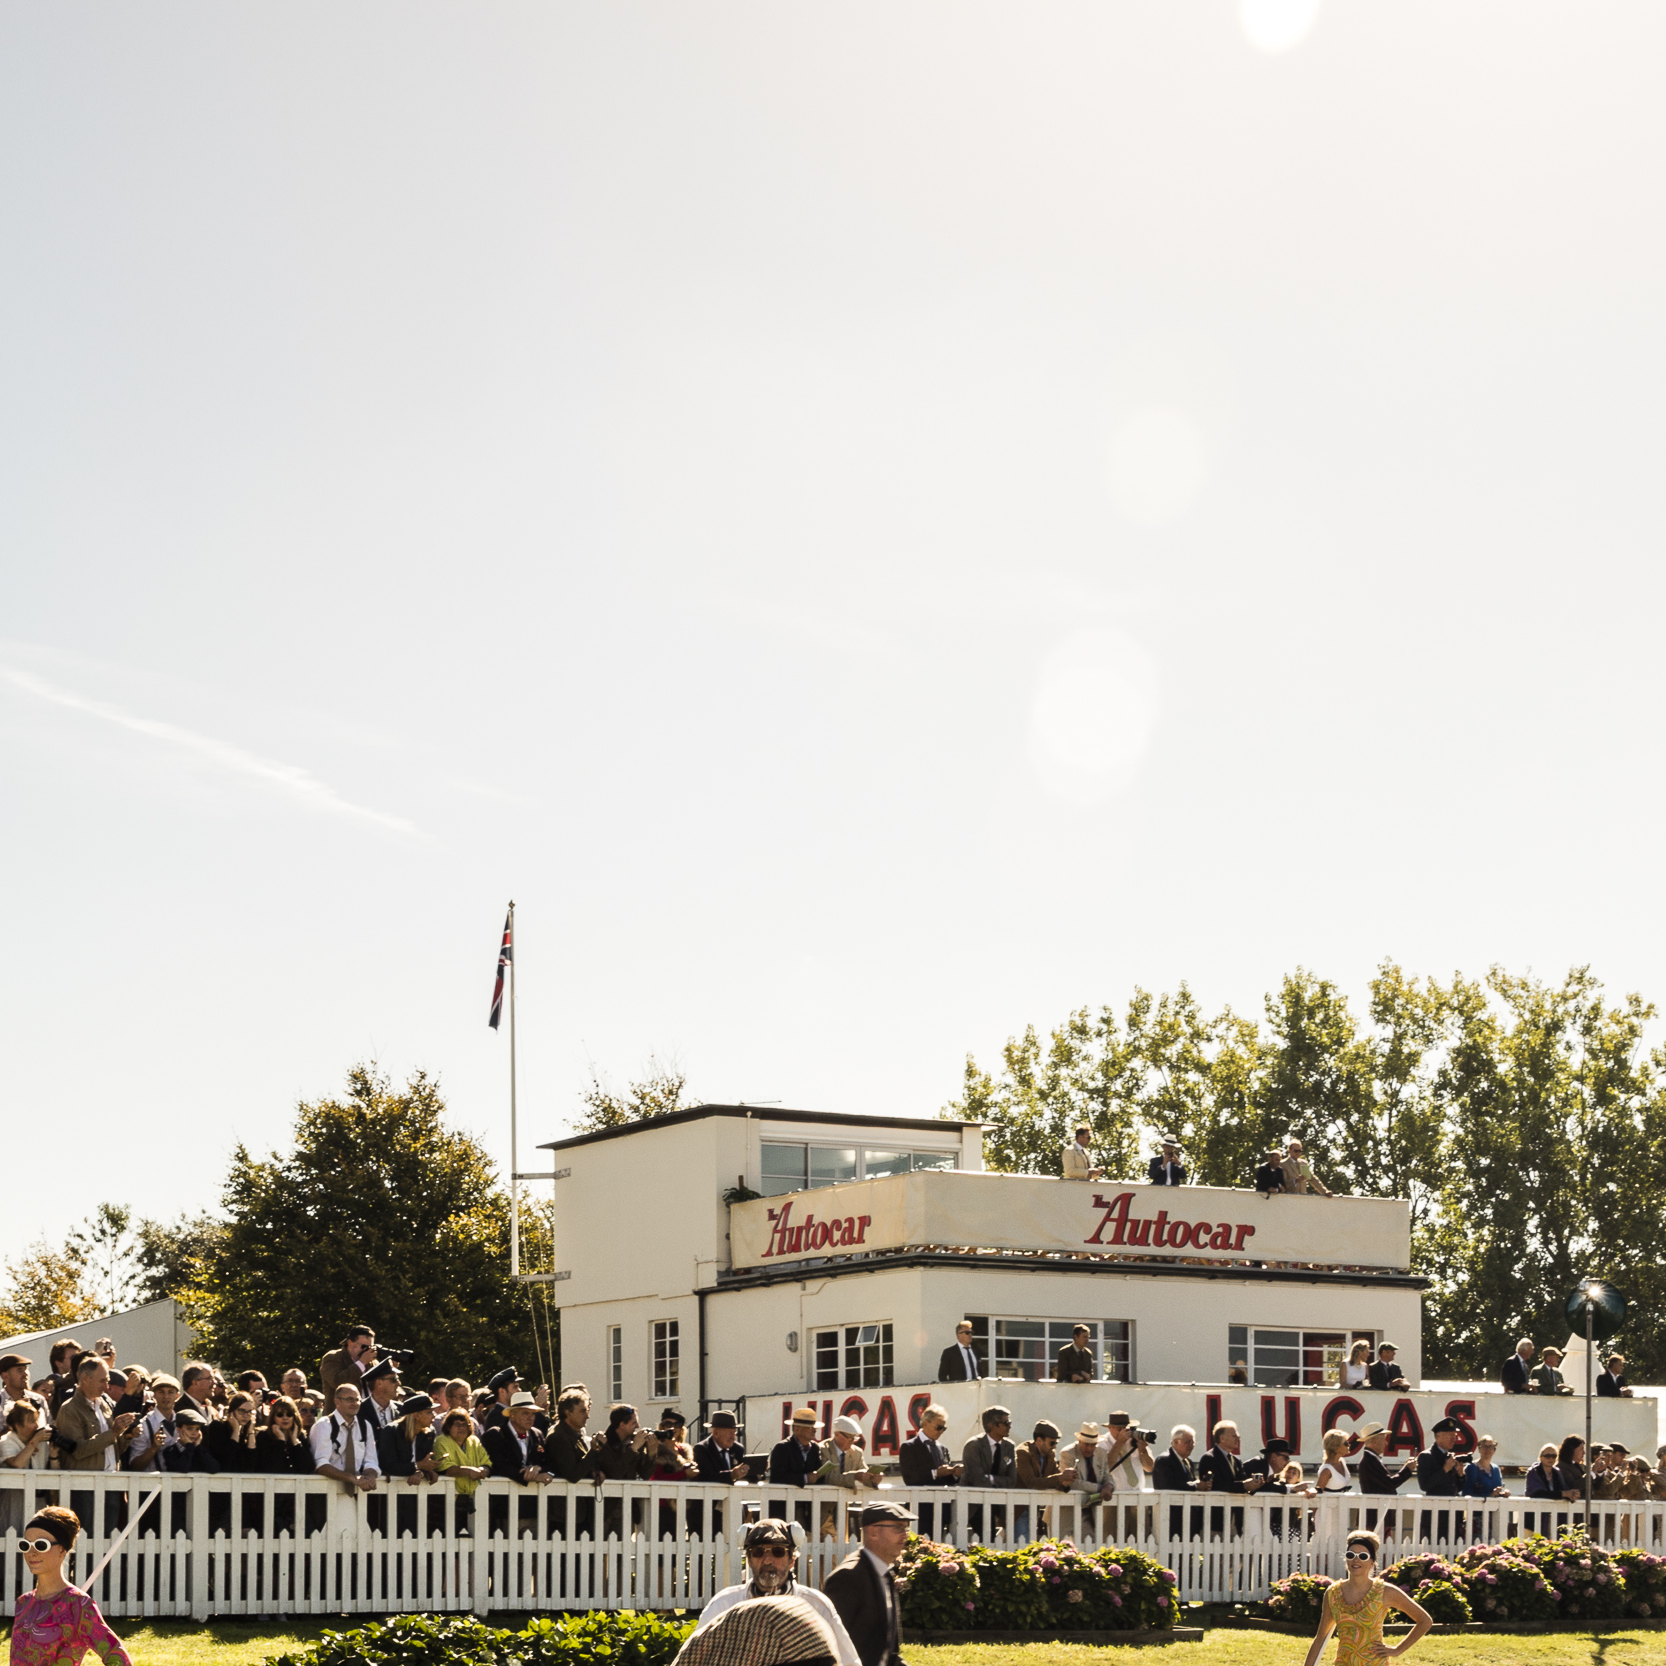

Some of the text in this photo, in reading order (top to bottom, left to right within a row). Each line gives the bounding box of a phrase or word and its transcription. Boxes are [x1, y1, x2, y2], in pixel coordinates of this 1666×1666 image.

[761, 1201, 872, 1258] Autocar
[1084, 1192, 1255, 1251] Autocar
[1206, 1394, 1479, 1457] LUCAS
